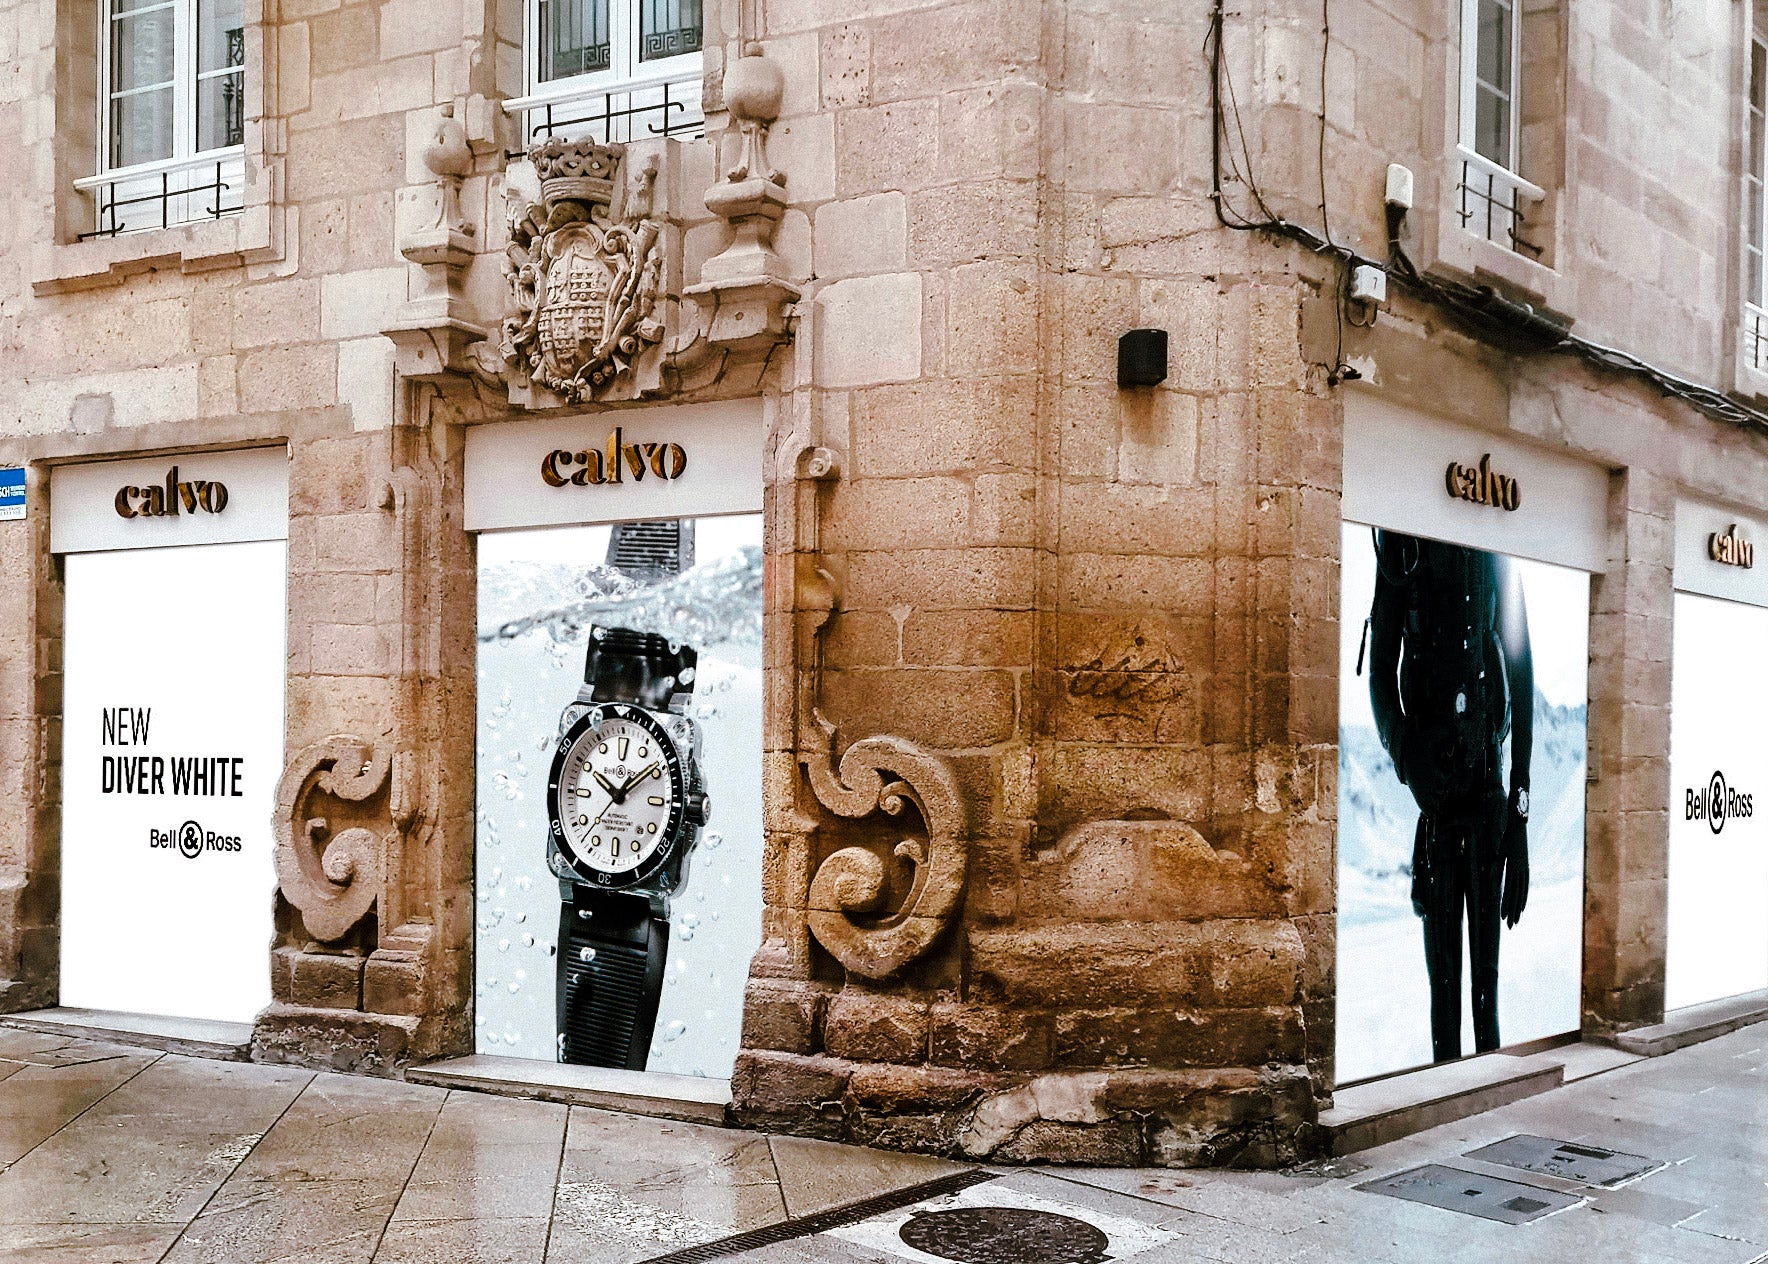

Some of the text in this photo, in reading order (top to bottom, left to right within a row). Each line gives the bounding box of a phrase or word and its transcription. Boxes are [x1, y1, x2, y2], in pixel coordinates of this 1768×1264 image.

[541, 427, 688, 487] calvo
[114, 466, 229, 518] calvo
[1445, 453, 1521, 512] calvo
[103, 708, 151, 746] NEW
[102, 755, 244, 797] DIVER WHITE
[1686, 787, 1707, 820] Bell
[1728, 787, 1753, 818] Ross
[150, 829, 176, 849] Bell
[206, 831, 242, 852] Ross
